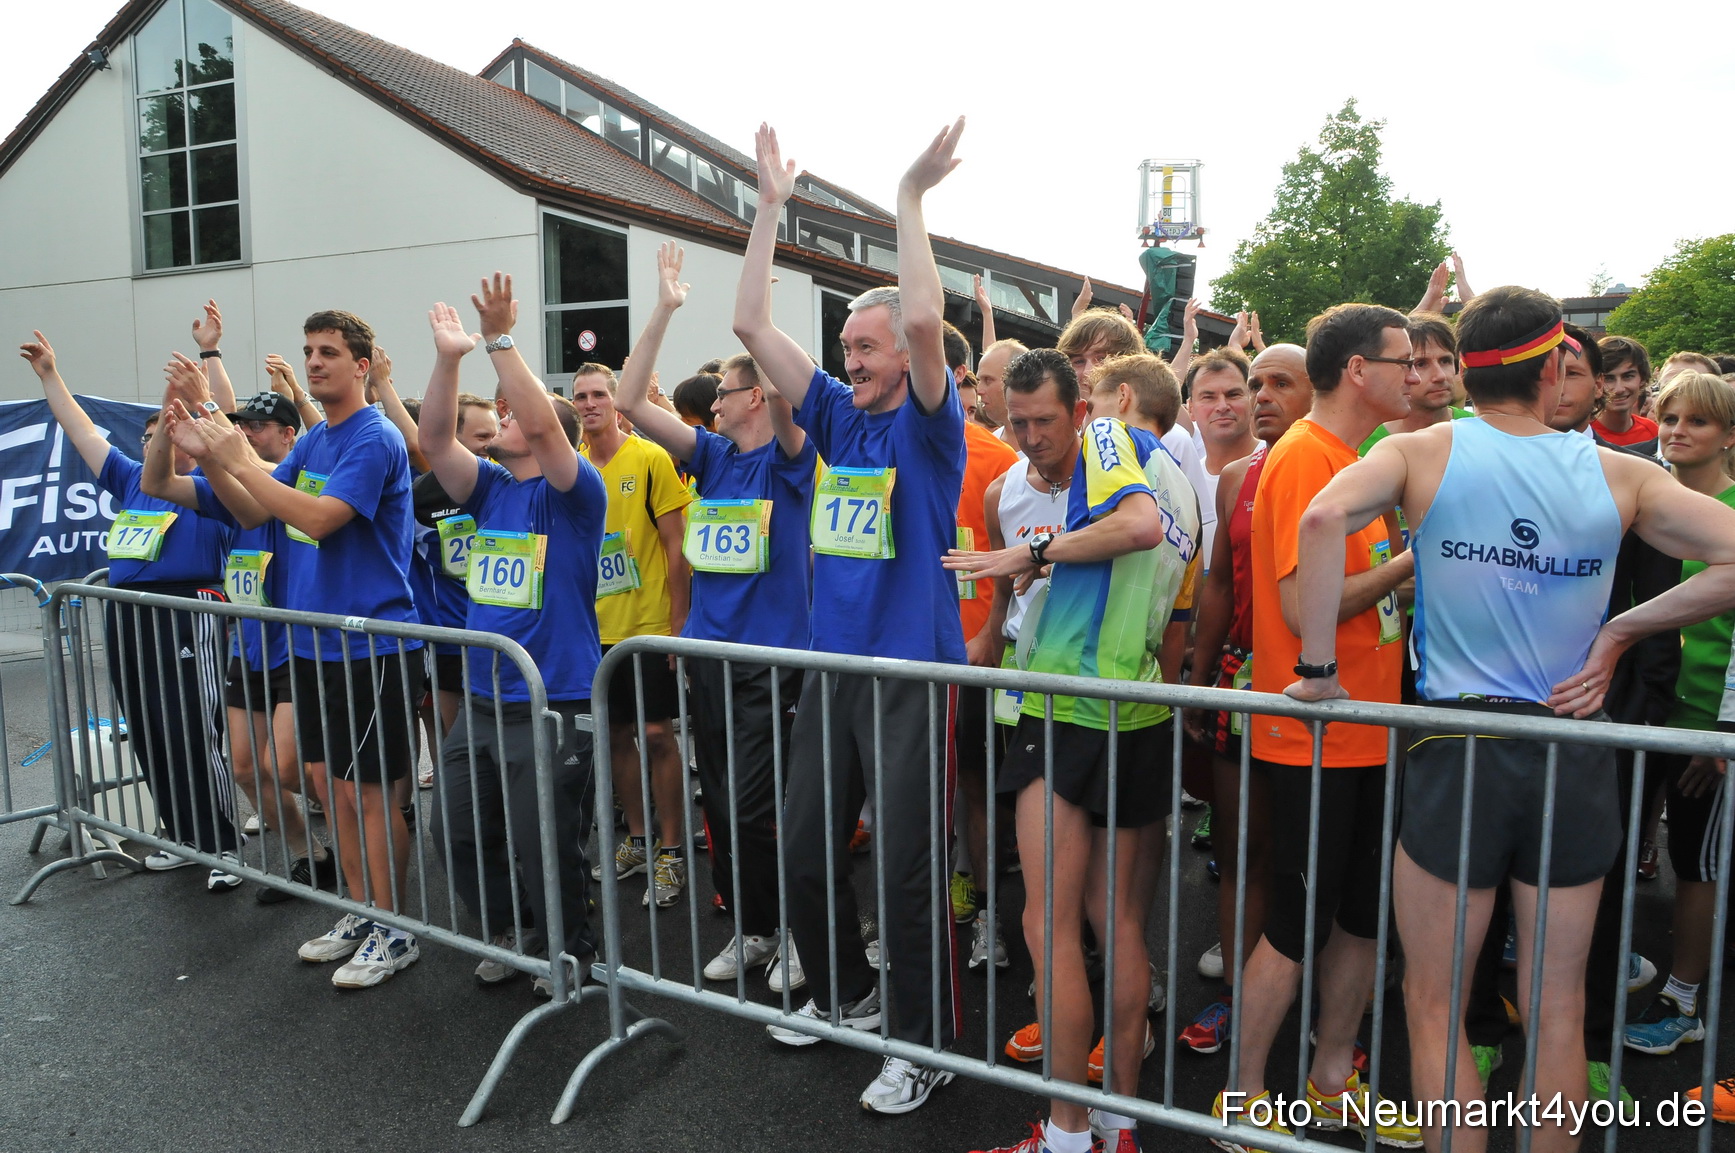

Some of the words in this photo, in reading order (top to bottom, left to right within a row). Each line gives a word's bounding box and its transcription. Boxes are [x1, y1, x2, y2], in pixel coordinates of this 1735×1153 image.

[621, 481, 634, 492] FC
[825, 497, 879, 535] 172
[117, 527, 154, 546] 171
[697, 525, 751, 554] 163
[834, 534, 855, 543] Josef
[699, 553, 731, 562] Christian
[1441, 540, 1603, 577] SCHABMÜLLER
[478, 555, 525, 588] 160
[232, 570, 258, 596] 161
[479, 585, 507, 595] Bernhard
[1500, 577, 1538, 595] TEAM
